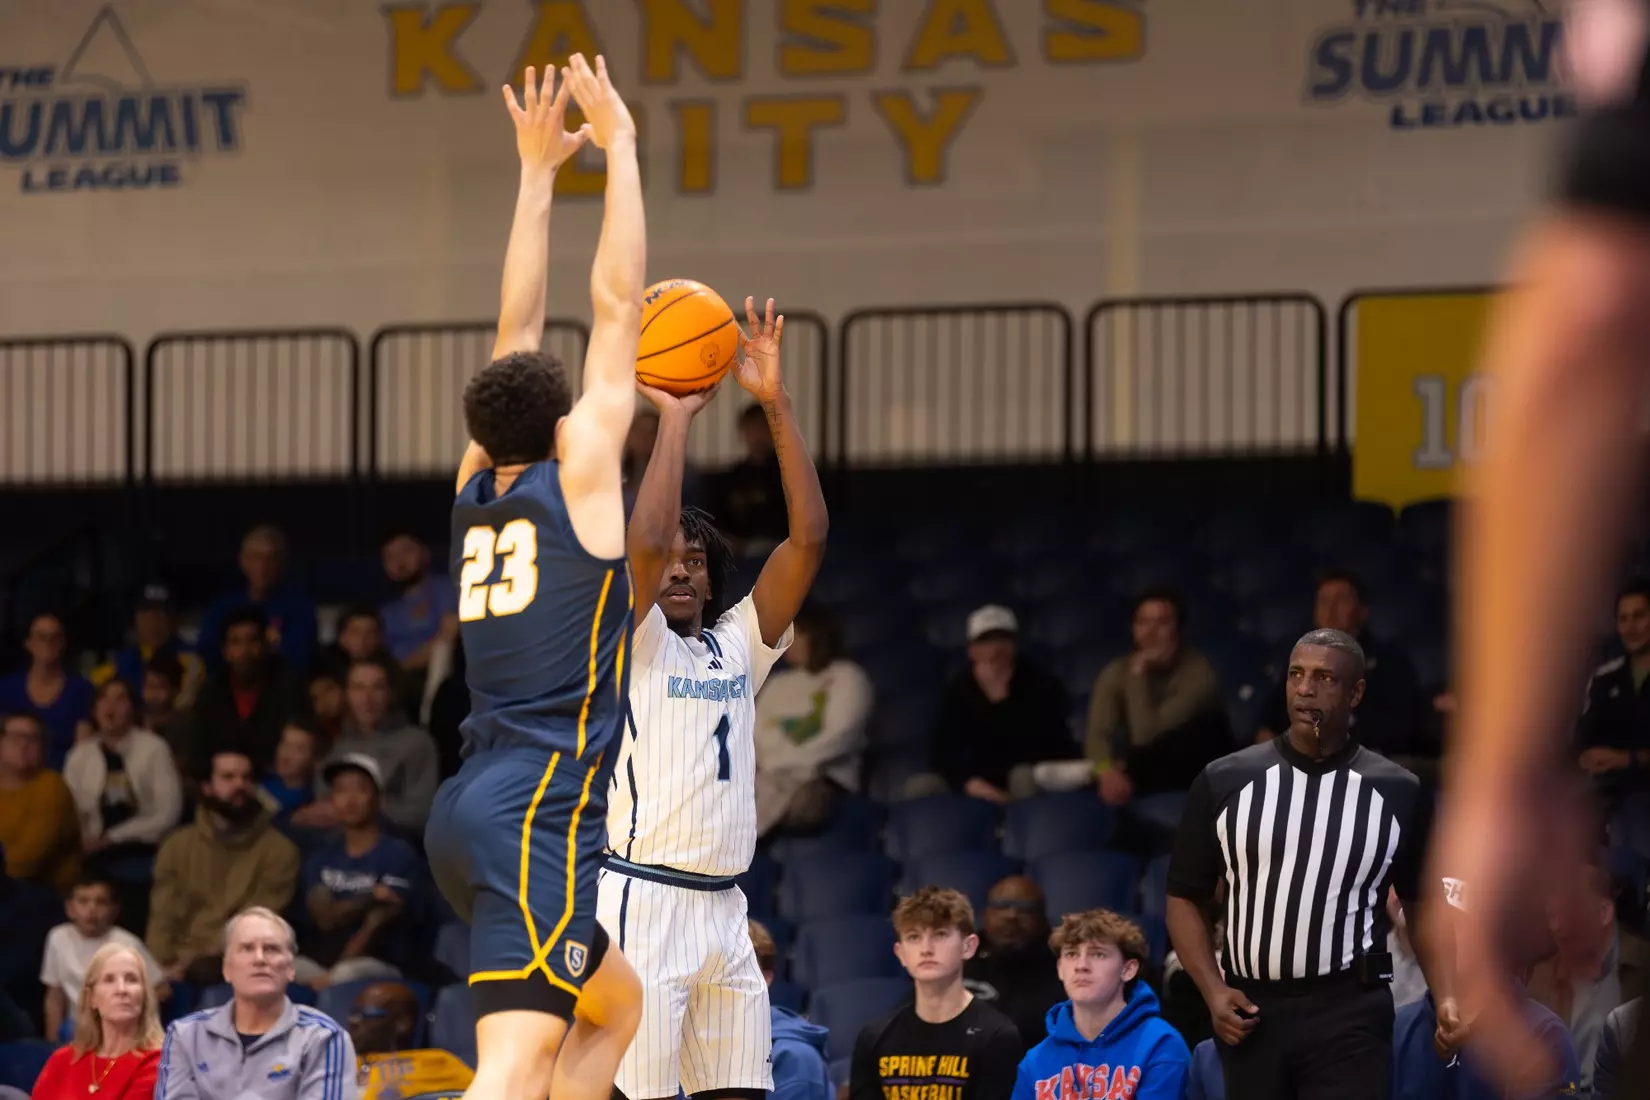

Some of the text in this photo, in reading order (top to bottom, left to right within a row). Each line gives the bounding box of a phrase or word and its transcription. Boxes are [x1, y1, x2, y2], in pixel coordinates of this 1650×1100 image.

[383, 0, 1147, 98] KANSAS
[1310, 22, 1563, 96] SUMM
[0, 90, 244, 158] UMMIT
[1390, 92, 1577, 128] LEAGUE
[21, 164, 181, 193] LEAGUE
[458, 517, 539, 622] 23
[711, 712, 732, 782] 1
[937, 1055, 969, 1078] HILL
